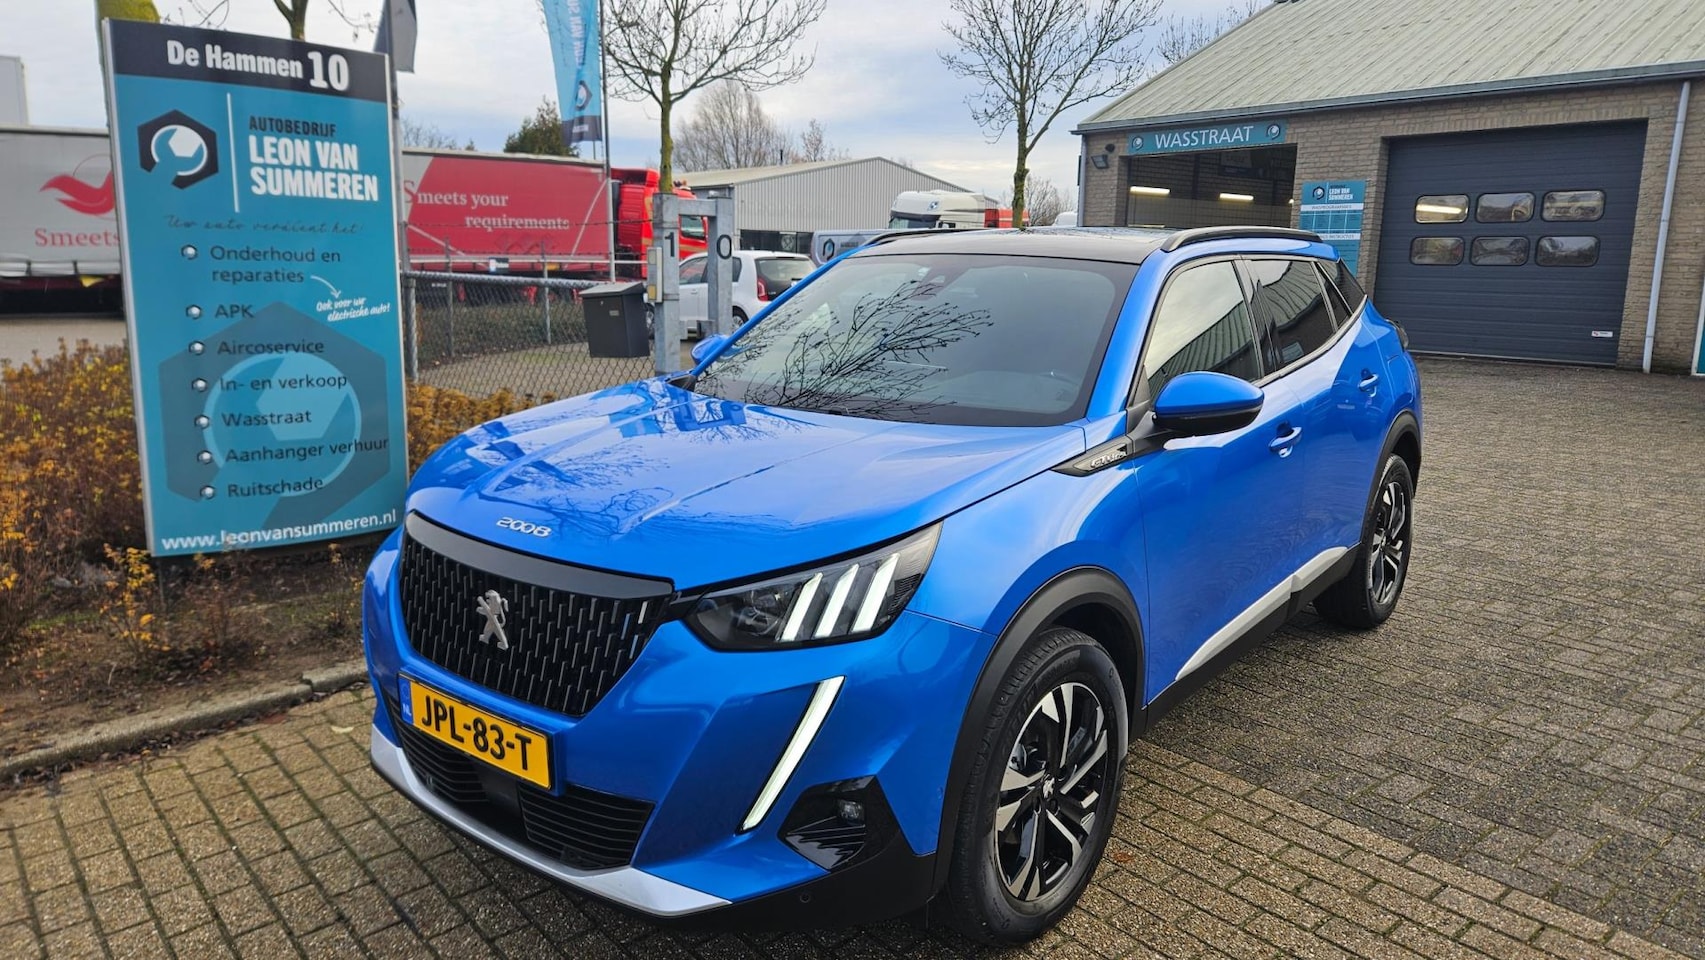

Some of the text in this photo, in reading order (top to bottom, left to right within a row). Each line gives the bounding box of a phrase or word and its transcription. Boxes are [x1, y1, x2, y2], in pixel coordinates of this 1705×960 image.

[166, 40, 349, 92] De Hammen 10
[249, 115, 337, 138] AUTOBEDRIJF
[1154, 125, 1254, 150] WASSTRAAT
[249, 135, 359, 171] LEON VAN
[250, 167, 378, 202] SUMMEREN
[471, 194, 509, 210] your
[464, 213, 570, 232] requirements
[210, 245, 341, 263] Onderhoud en
[665, 231, 675, 258] 1
[212, 267, 305, 285] reparaties
[214, 303, 255, 319] APK
[316, 298, 332, 312] Ook
[334, 299, 352, 310] voor
[217, 338, 325, 355] Aircoservice
[220, 373, 347, 391] In- en verkoop
[222, 409, 312, 428] Wasstraat
[225, 437, 389, 464] Aanhanger verhuur
[228, 477, 324, 498] Ruitschade
[161, 508, 397, 551] www.leonvansummeren.nl
[496, 516, 552, 537] 2008
[402, 703, 412, 717] NL
[421, 695, 532, 771] JPL-83-T
